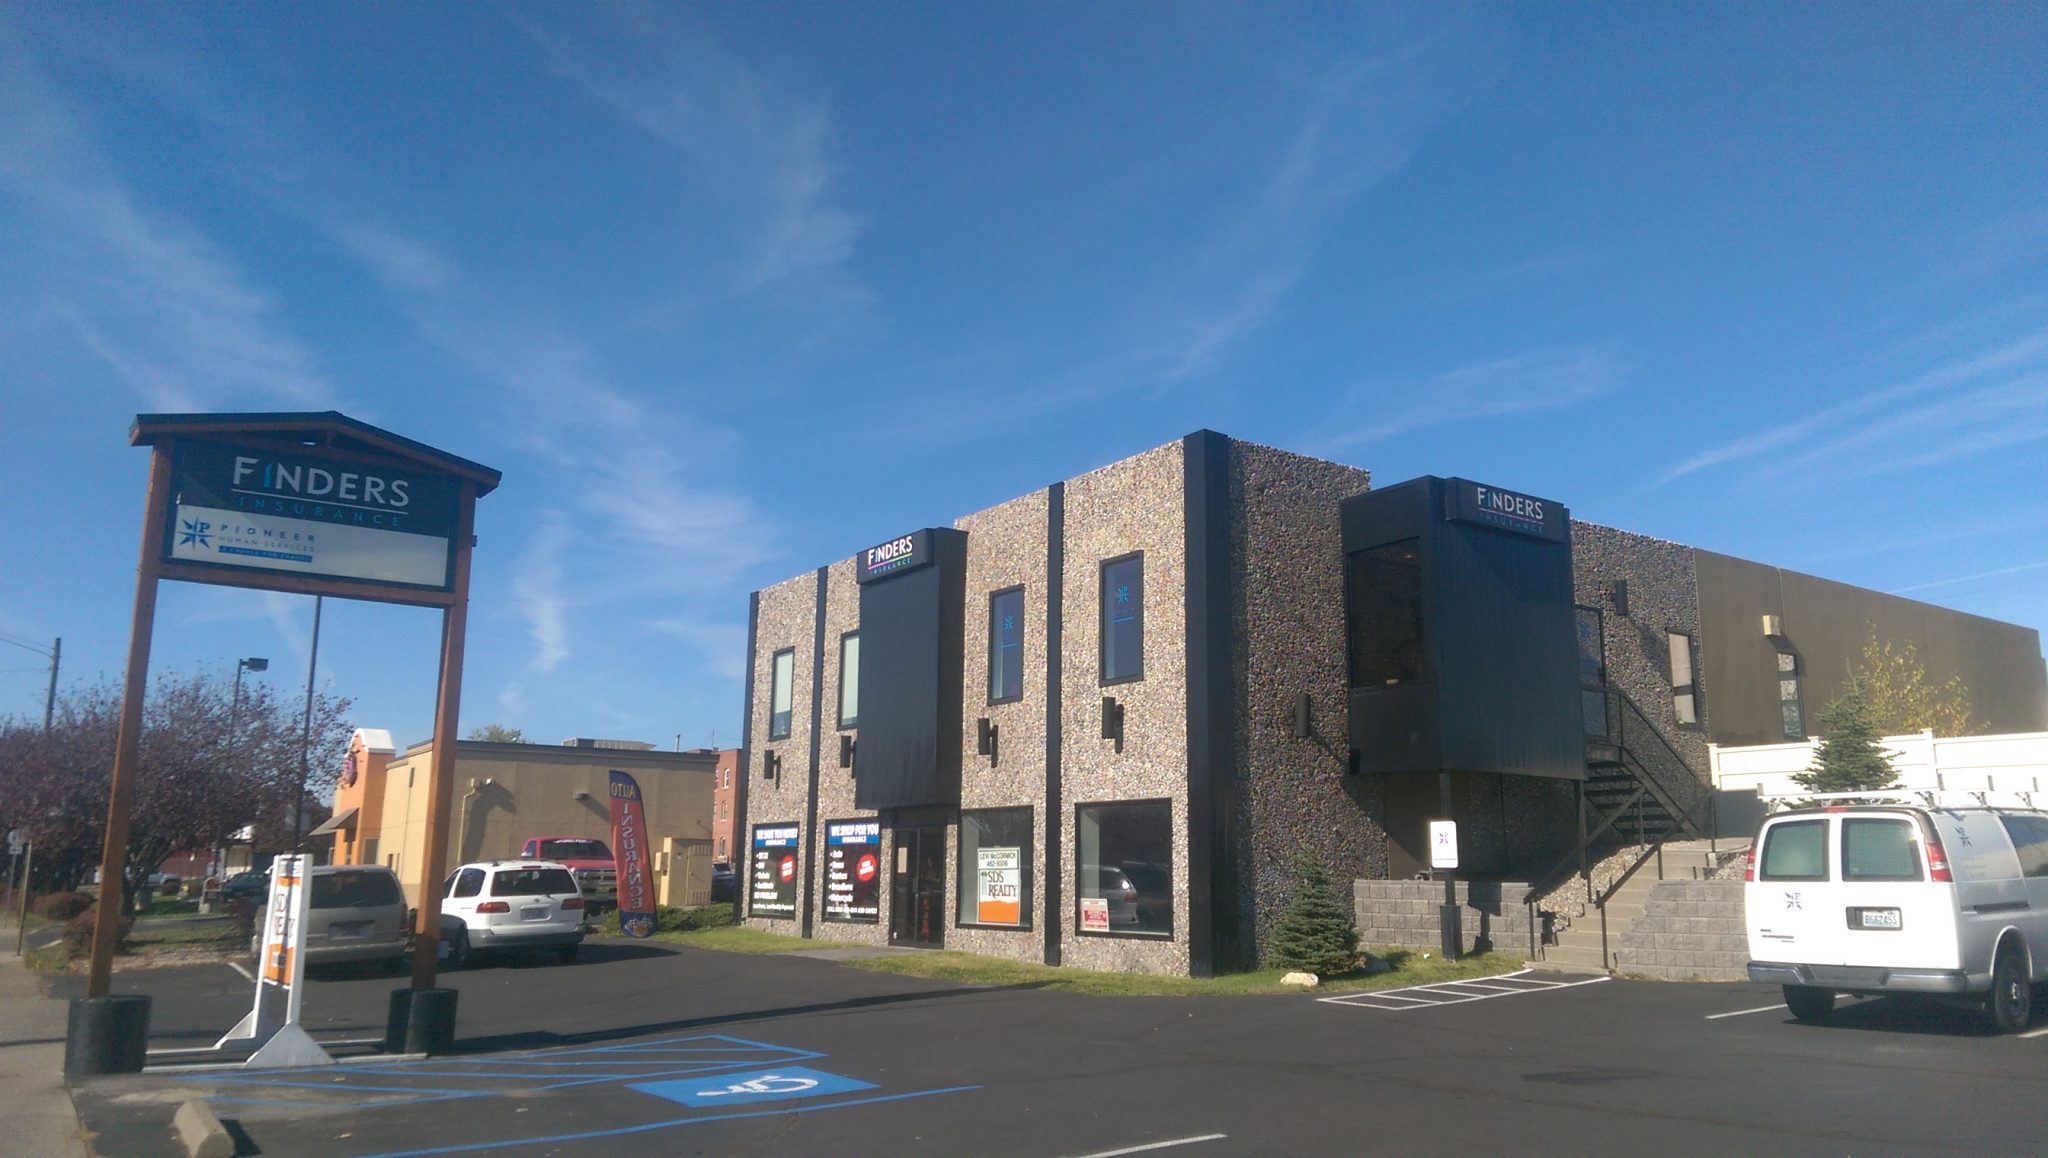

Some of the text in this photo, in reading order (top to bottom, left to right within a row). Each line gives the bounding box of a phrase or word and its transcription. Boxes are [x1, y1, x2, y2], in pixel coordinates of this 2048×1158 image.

[232, 456, 409, 507] FINDERS
[239, 496, 400, 527] INSURANCE
[1477, 487, 1543, 520] FINDERS
[218, 537, 258, 545] HUMAN
[220, 523, 315, 542] PIONEER
[868, 535, 913, 566] FINDERS
[855, 824, 866, 836] FOR
[867, 823, 879, 835] YOU
[988, 871, 1004, 883] SDS
[988, 884, 1018, 899] REALTY
